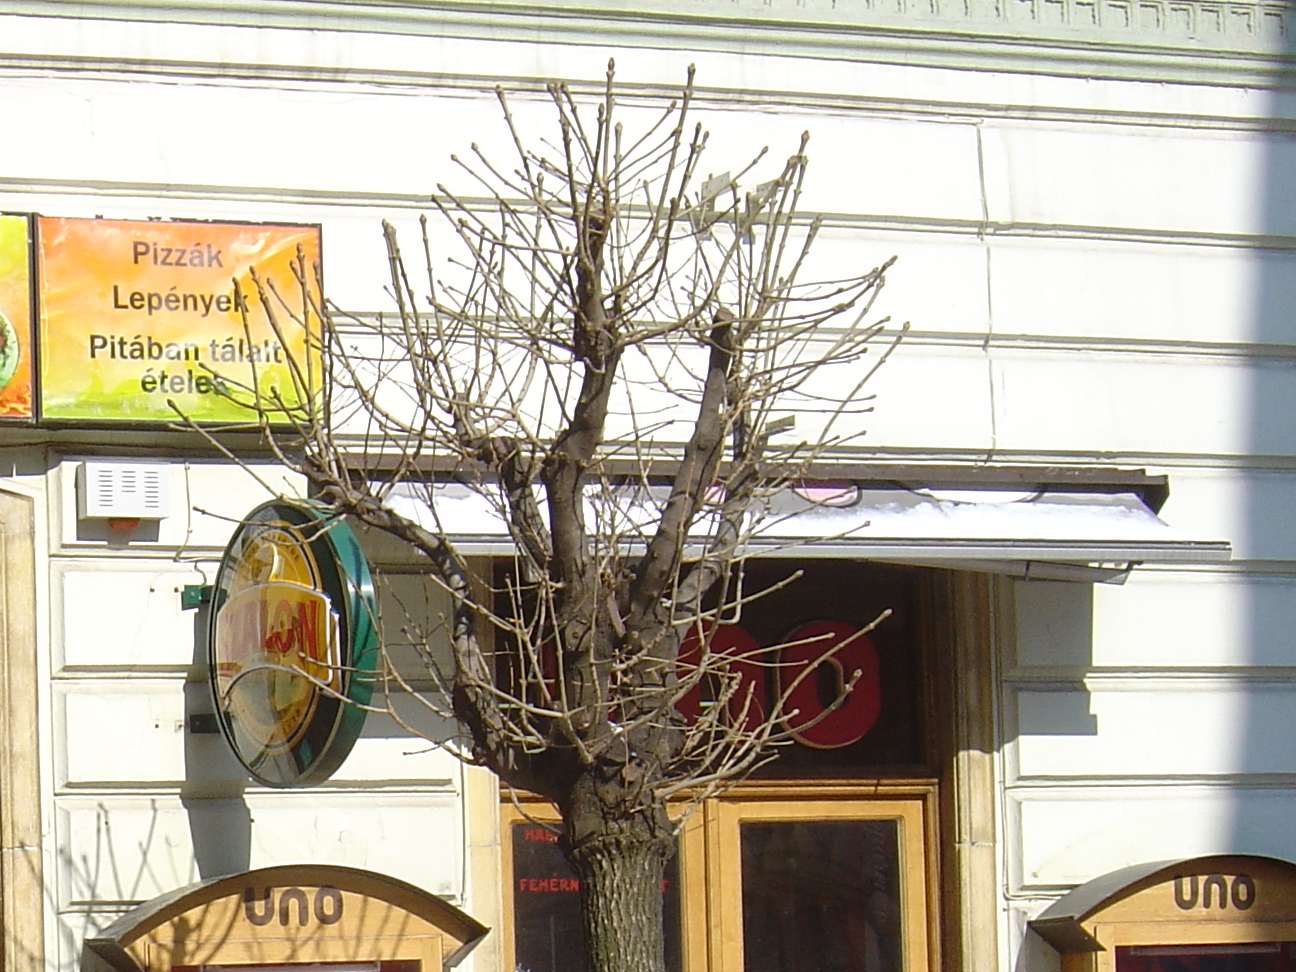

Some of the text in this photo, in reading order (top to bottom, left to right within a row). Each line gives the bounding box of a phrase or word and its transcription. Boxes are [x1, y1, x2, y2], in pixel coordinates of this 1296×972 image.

[132, 241, 224, 268] Pizzák
[113, 285, 250, 318] Lepények
[89, 334, 282, 363] Pitában tálalt
